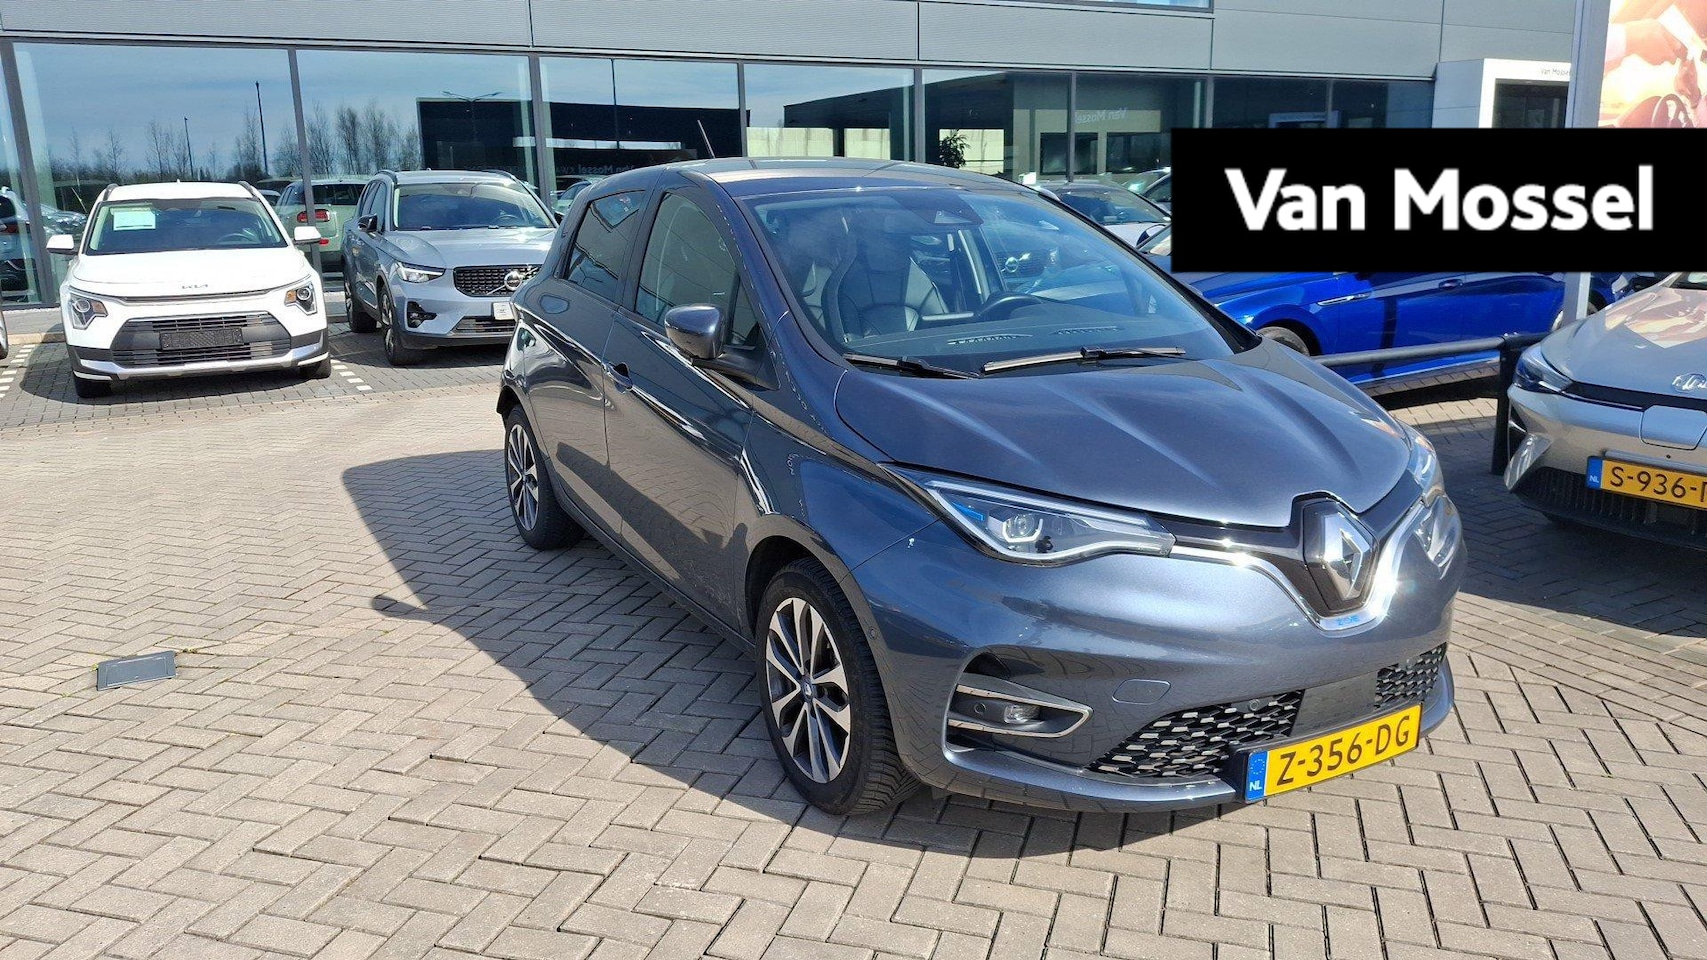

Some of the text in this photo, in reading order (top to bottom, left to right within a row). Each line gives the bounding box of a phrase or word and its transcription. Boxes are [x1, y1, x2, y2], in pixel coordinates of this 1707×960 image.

[1589, 475, 1600, 483] NL
[1276, 715, 1410, 787] Z-356-DG
[1250, 781, 1263, 791] NL
